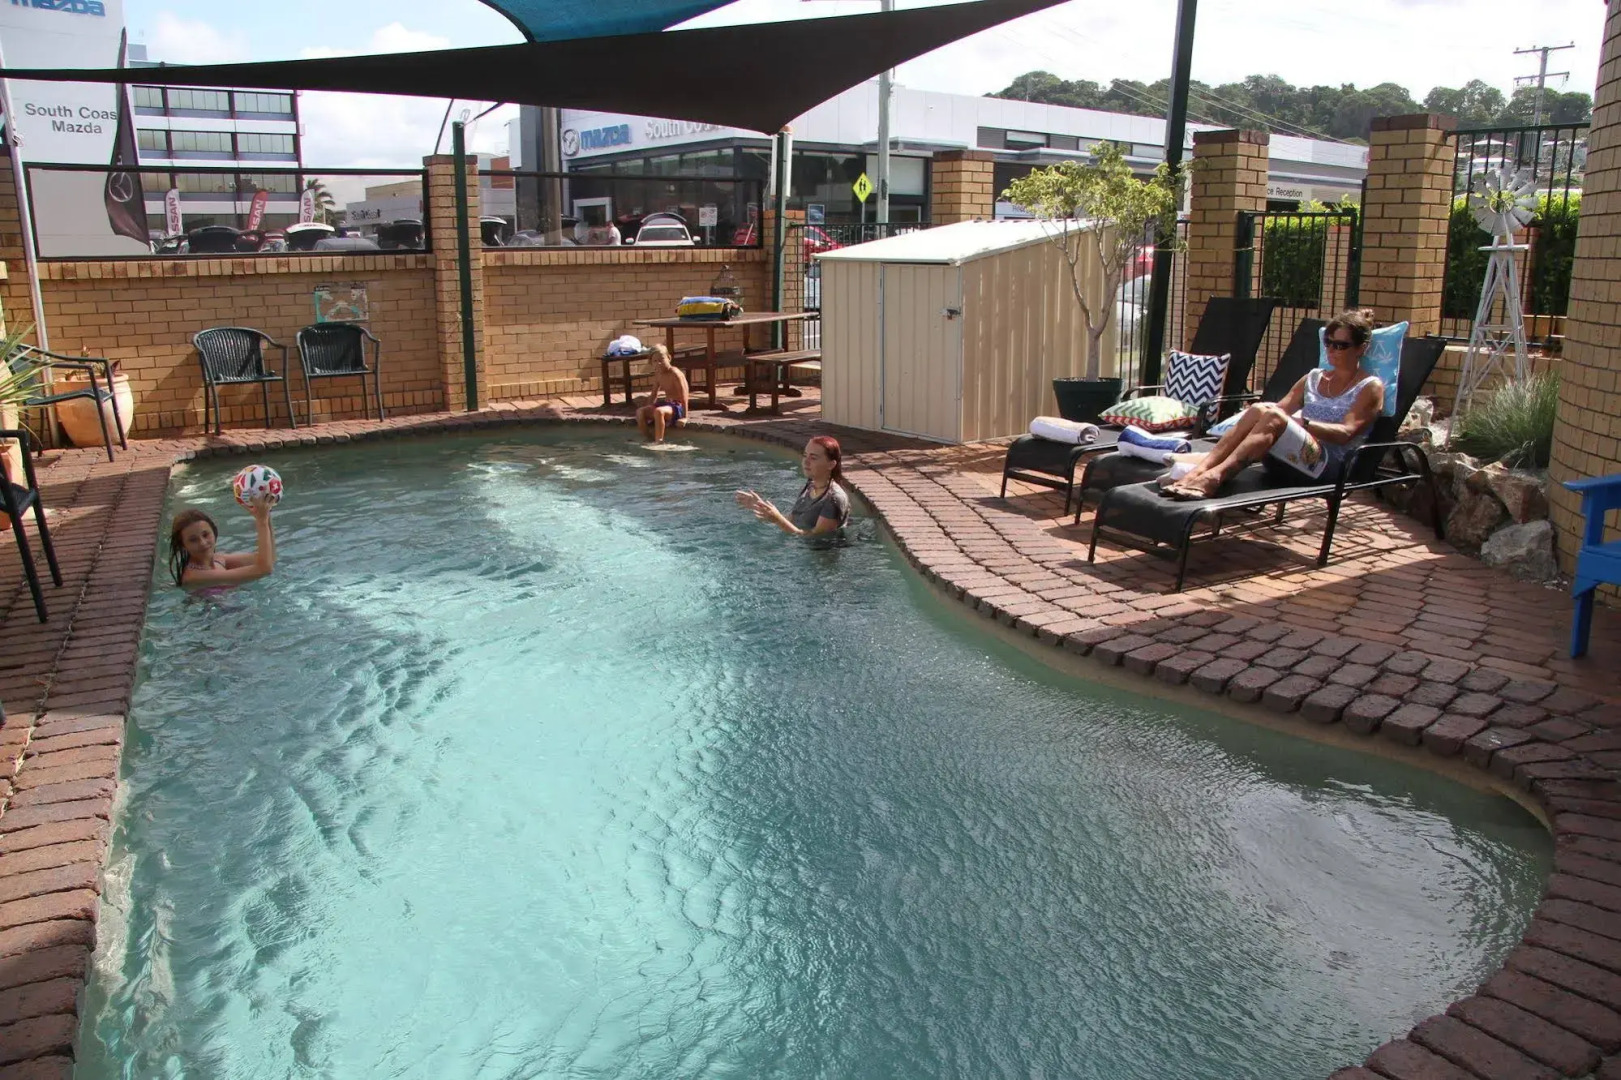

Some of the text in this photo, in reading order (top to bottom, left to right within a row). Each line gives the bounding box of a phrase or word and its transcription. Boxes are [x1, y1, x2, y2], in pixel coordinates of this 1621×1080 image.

[25, 103, 117, 120] South Coas
[52, 120, 102, 133] Mazda
[1276, 187, 1303, 198] Reception
[168, 197, 180, 232] SSAN
[303, 197, 311, 222] SAN
